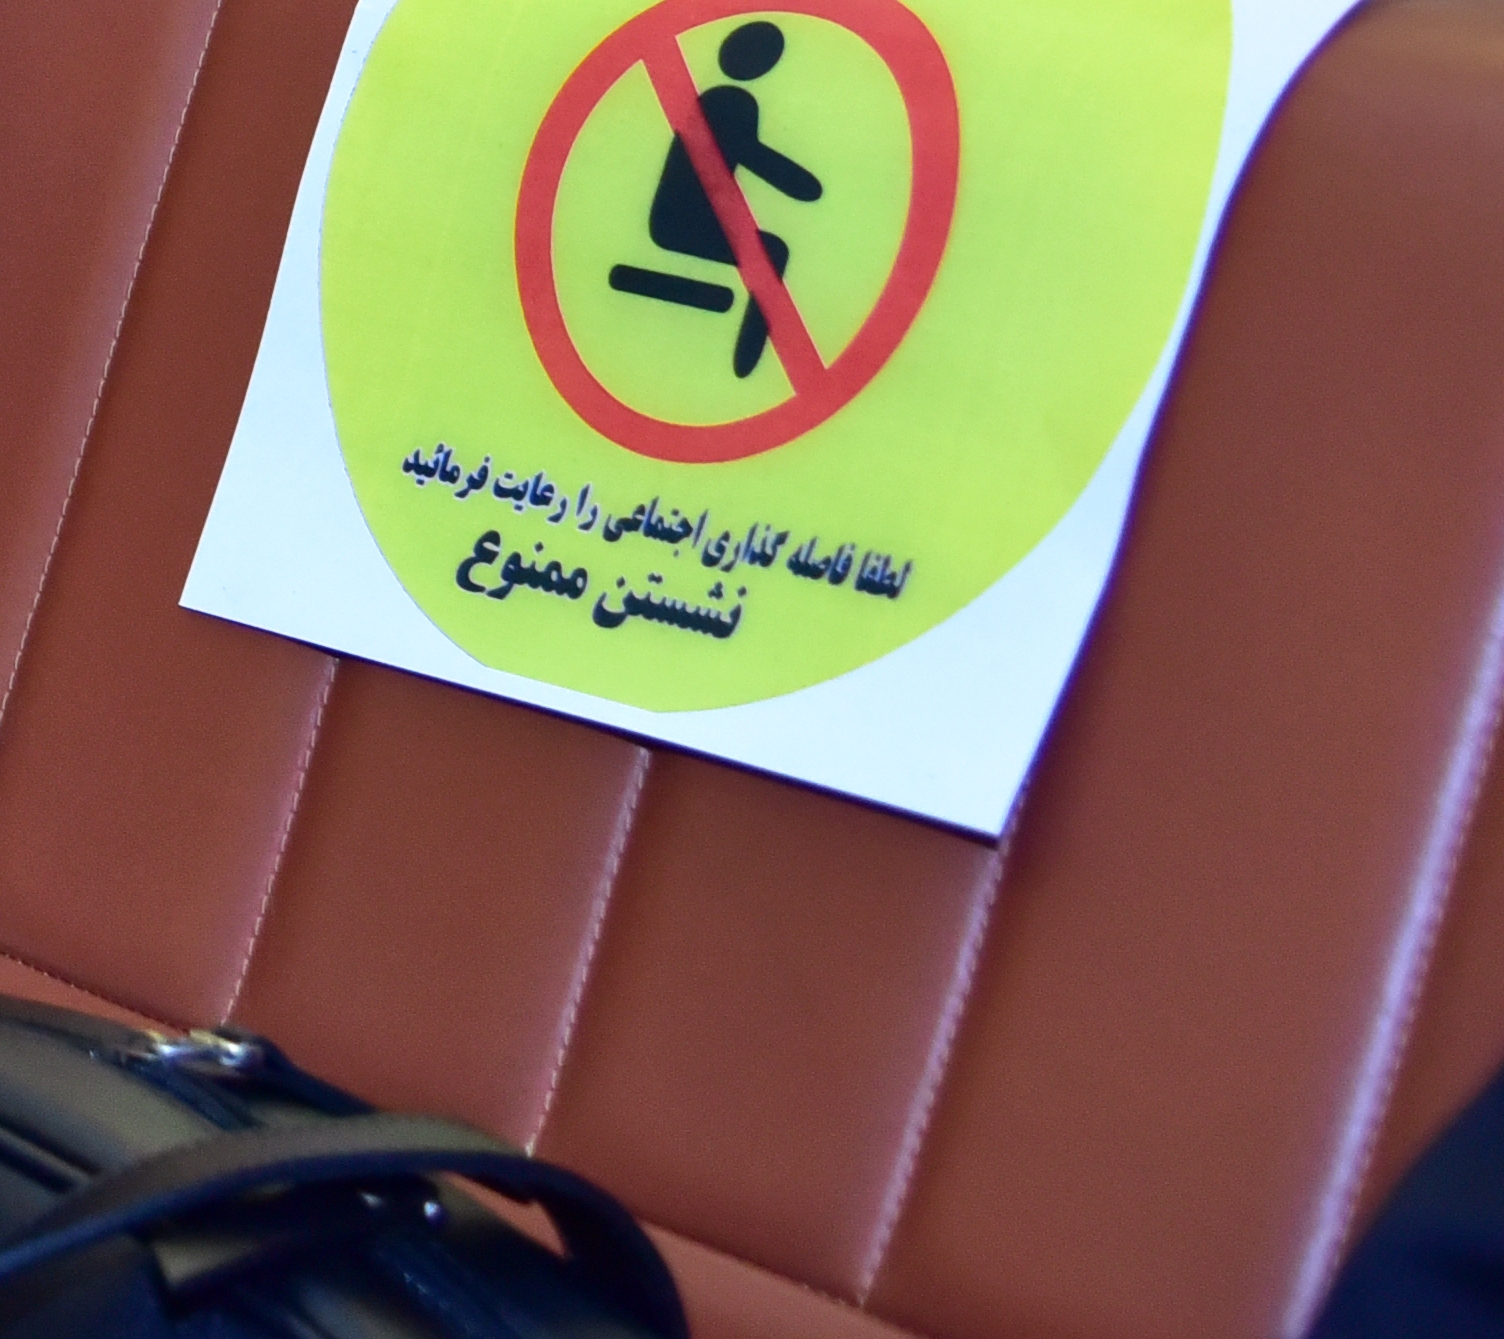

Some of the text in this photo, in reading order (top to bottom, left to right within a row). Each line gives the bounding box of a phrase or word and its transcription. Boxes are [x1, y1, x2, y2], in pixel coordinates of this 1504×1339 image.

[402, 442, 913, 600] لطفا فاصله گذاری اجتماعی را رعایت فرمائید
[456, 529, 747, 639] نشستن ممنوع
